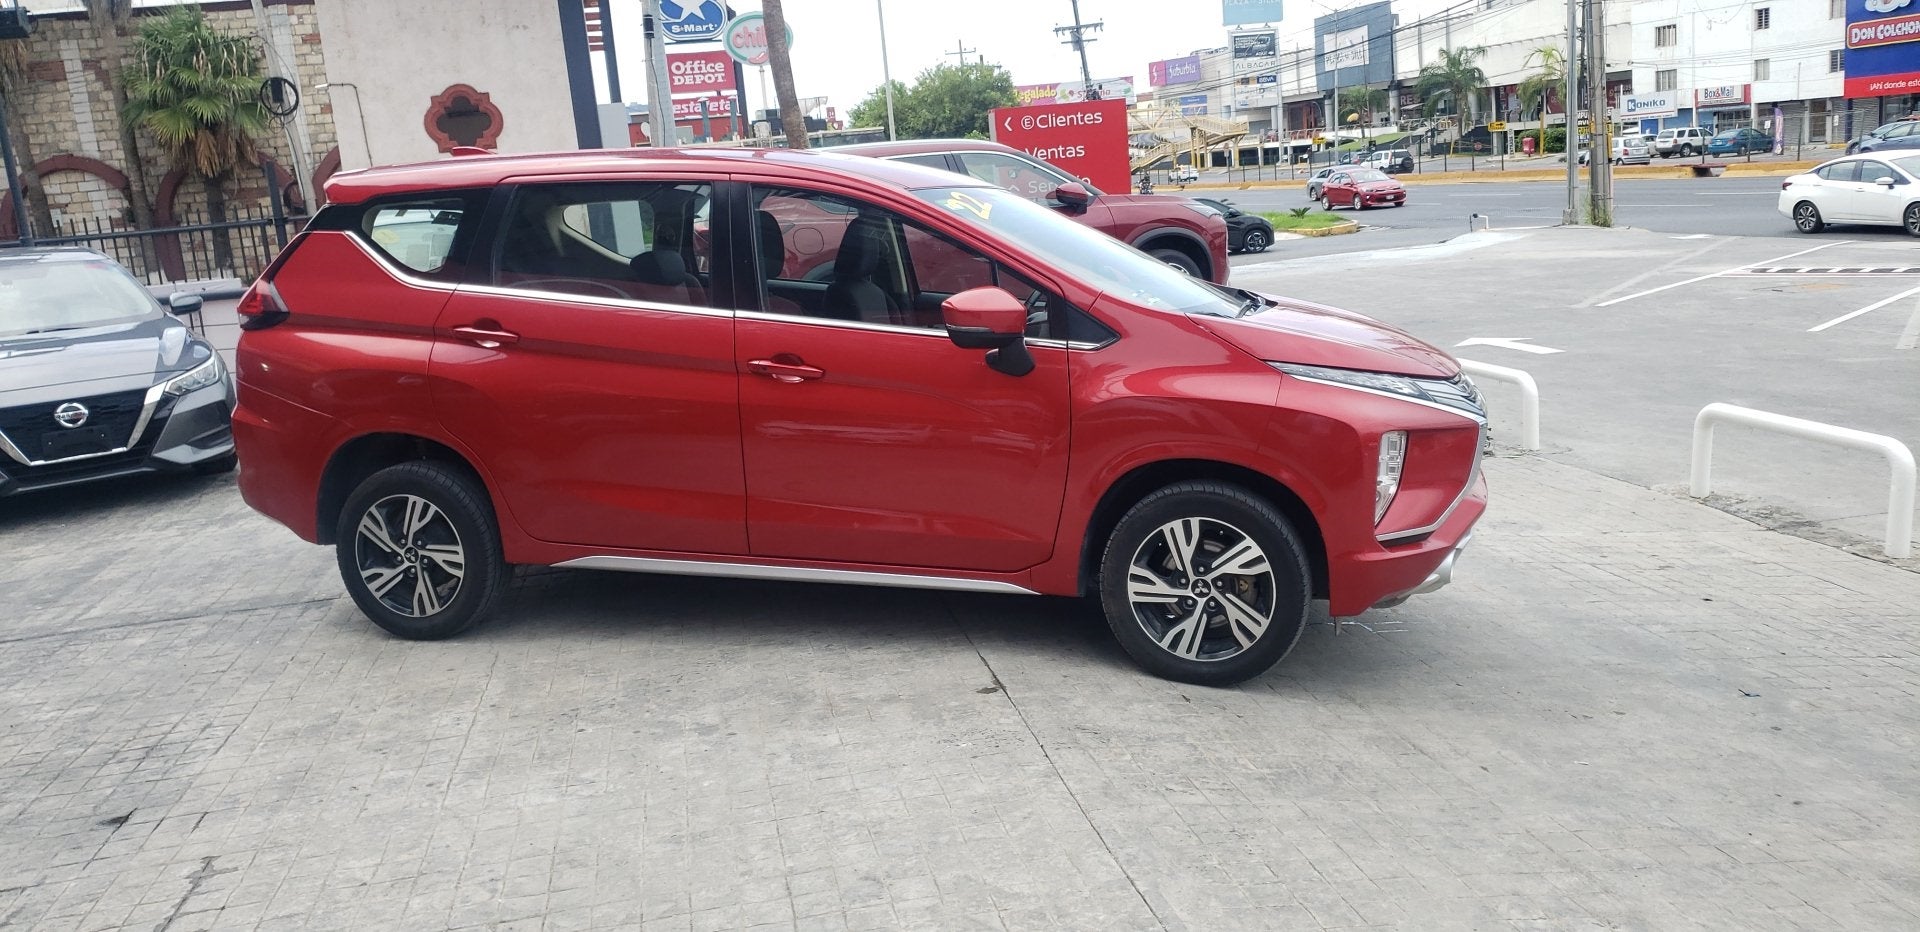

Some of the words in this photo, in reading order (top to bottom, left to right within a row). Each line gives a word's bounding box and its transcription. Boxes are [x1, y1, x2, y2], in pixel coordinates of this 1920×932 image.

[732, 26, 768, 49] chil
[1852, 27, 1875, 43] DON
[671, 61, 725, 75] Office
[673, 73, 726, 86] DEPOT
[1884, 80, 1906, 89] donde
[673, 99, 731, 114] estaeta
[1036, 112, 1103, 128] Clientes
[1025, 145, 1085, 160] Ventas
